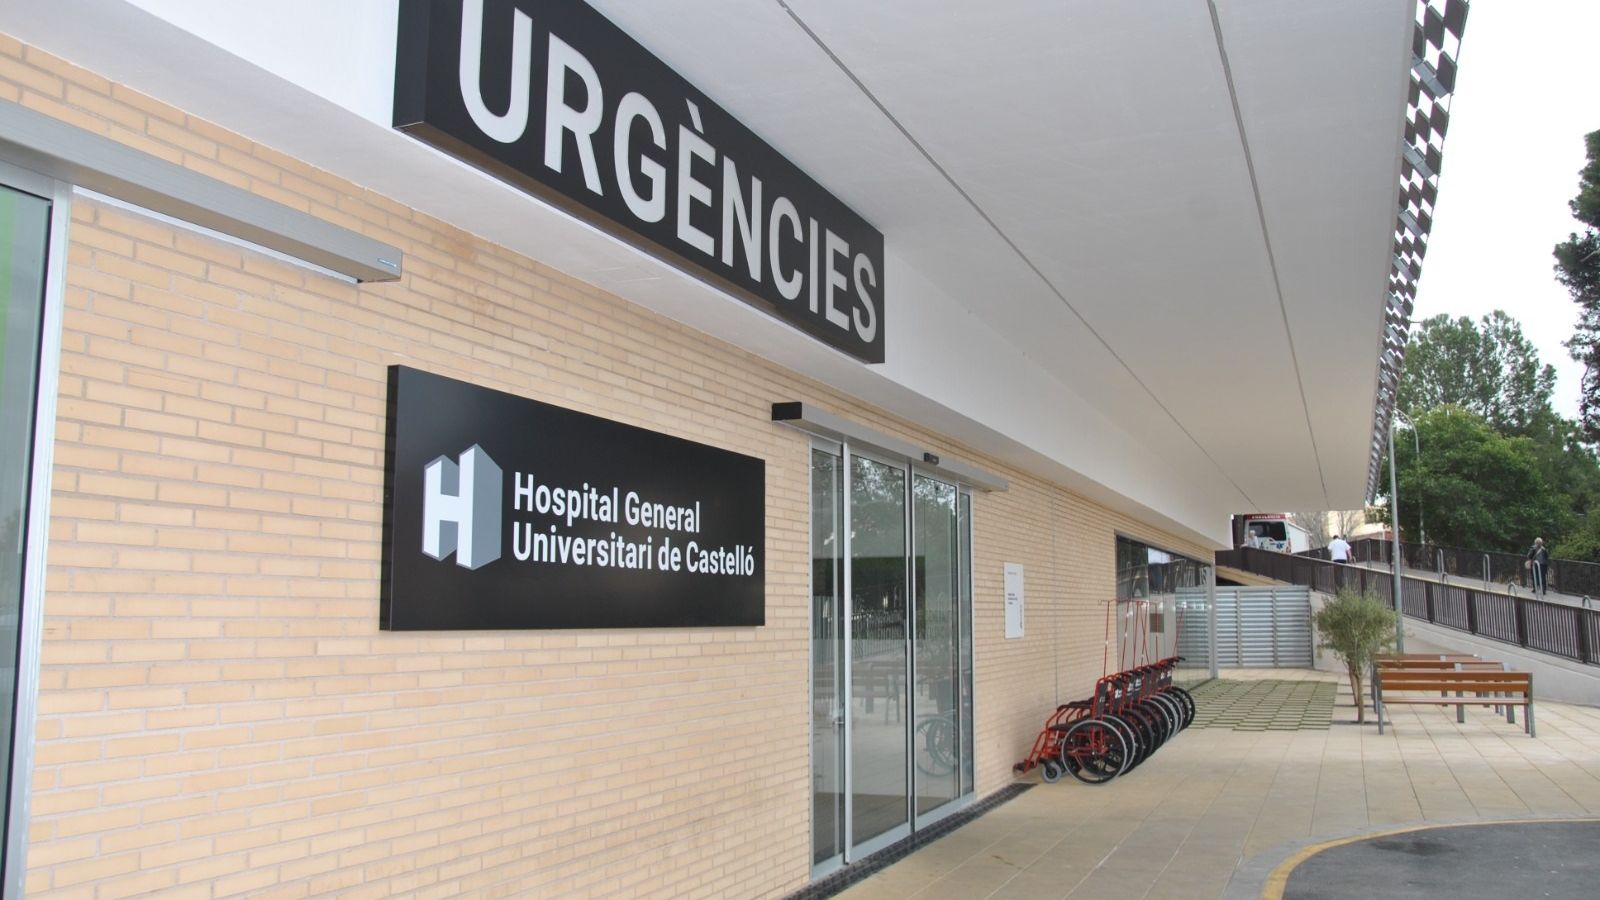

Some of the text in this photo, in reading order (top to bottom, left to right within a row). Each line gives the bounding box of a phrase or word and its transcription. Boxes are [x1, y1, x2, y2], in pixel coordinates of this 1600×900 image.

[459, 0, 877, 343] URGÈNCIES
[514, 471, 700, 534] Hospital General
[512, 521, 755, 577] Universitari de Castelló
